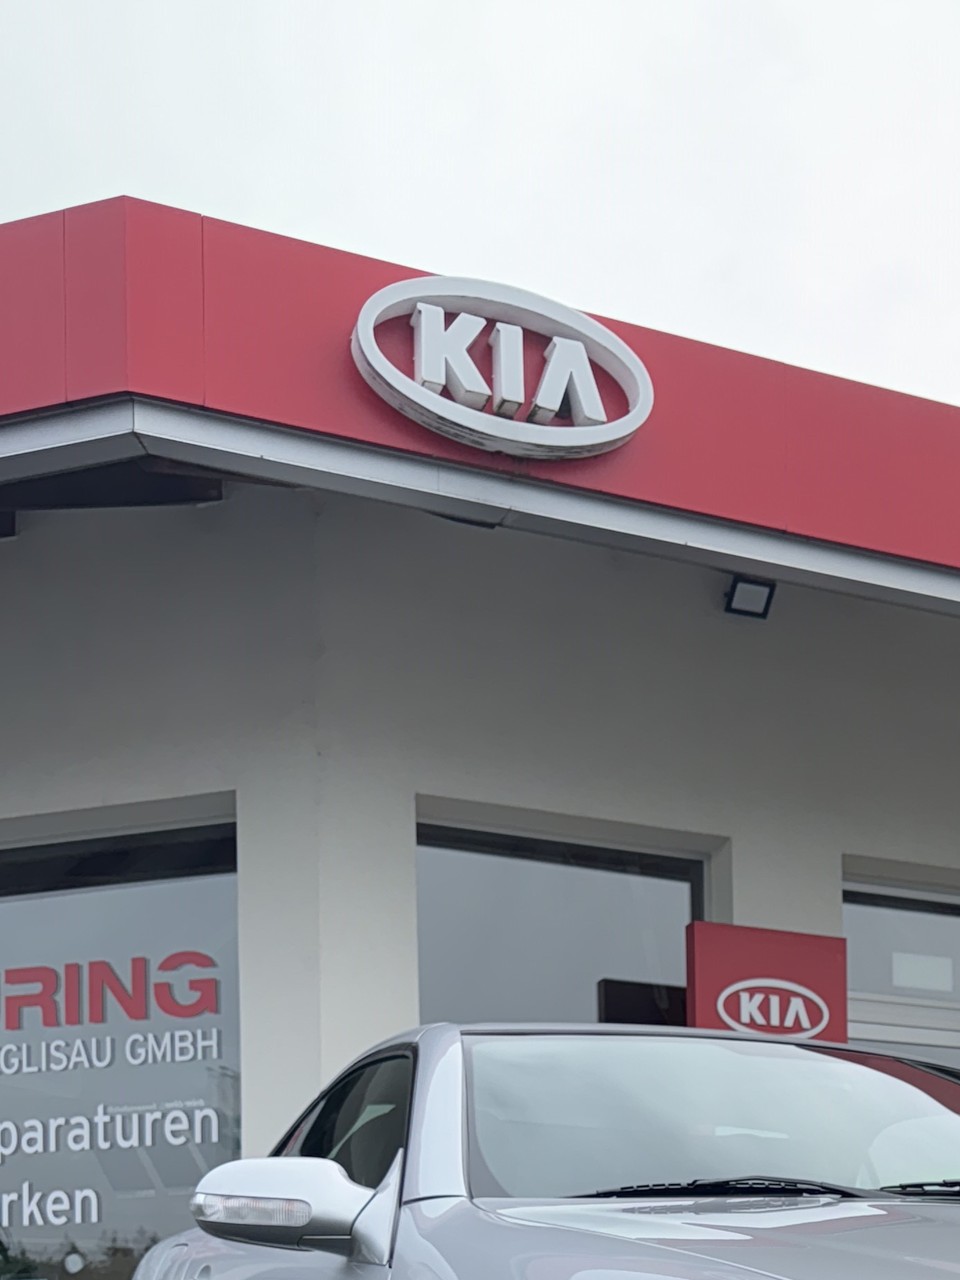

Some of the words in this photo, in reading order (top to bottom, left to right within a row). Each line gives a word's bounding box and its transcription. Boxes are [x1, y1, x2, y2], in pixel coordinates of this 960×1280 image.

[411, 301, 608, 427] KIA
[4, 951, 219, 1031] RING
[738, 991, 812, 1029] KIA
[0, 1036, 112, 1075] GLISAU
[125, 1028, 219, 1066] GMBH
[0, 1181, 99, 1227] rken
